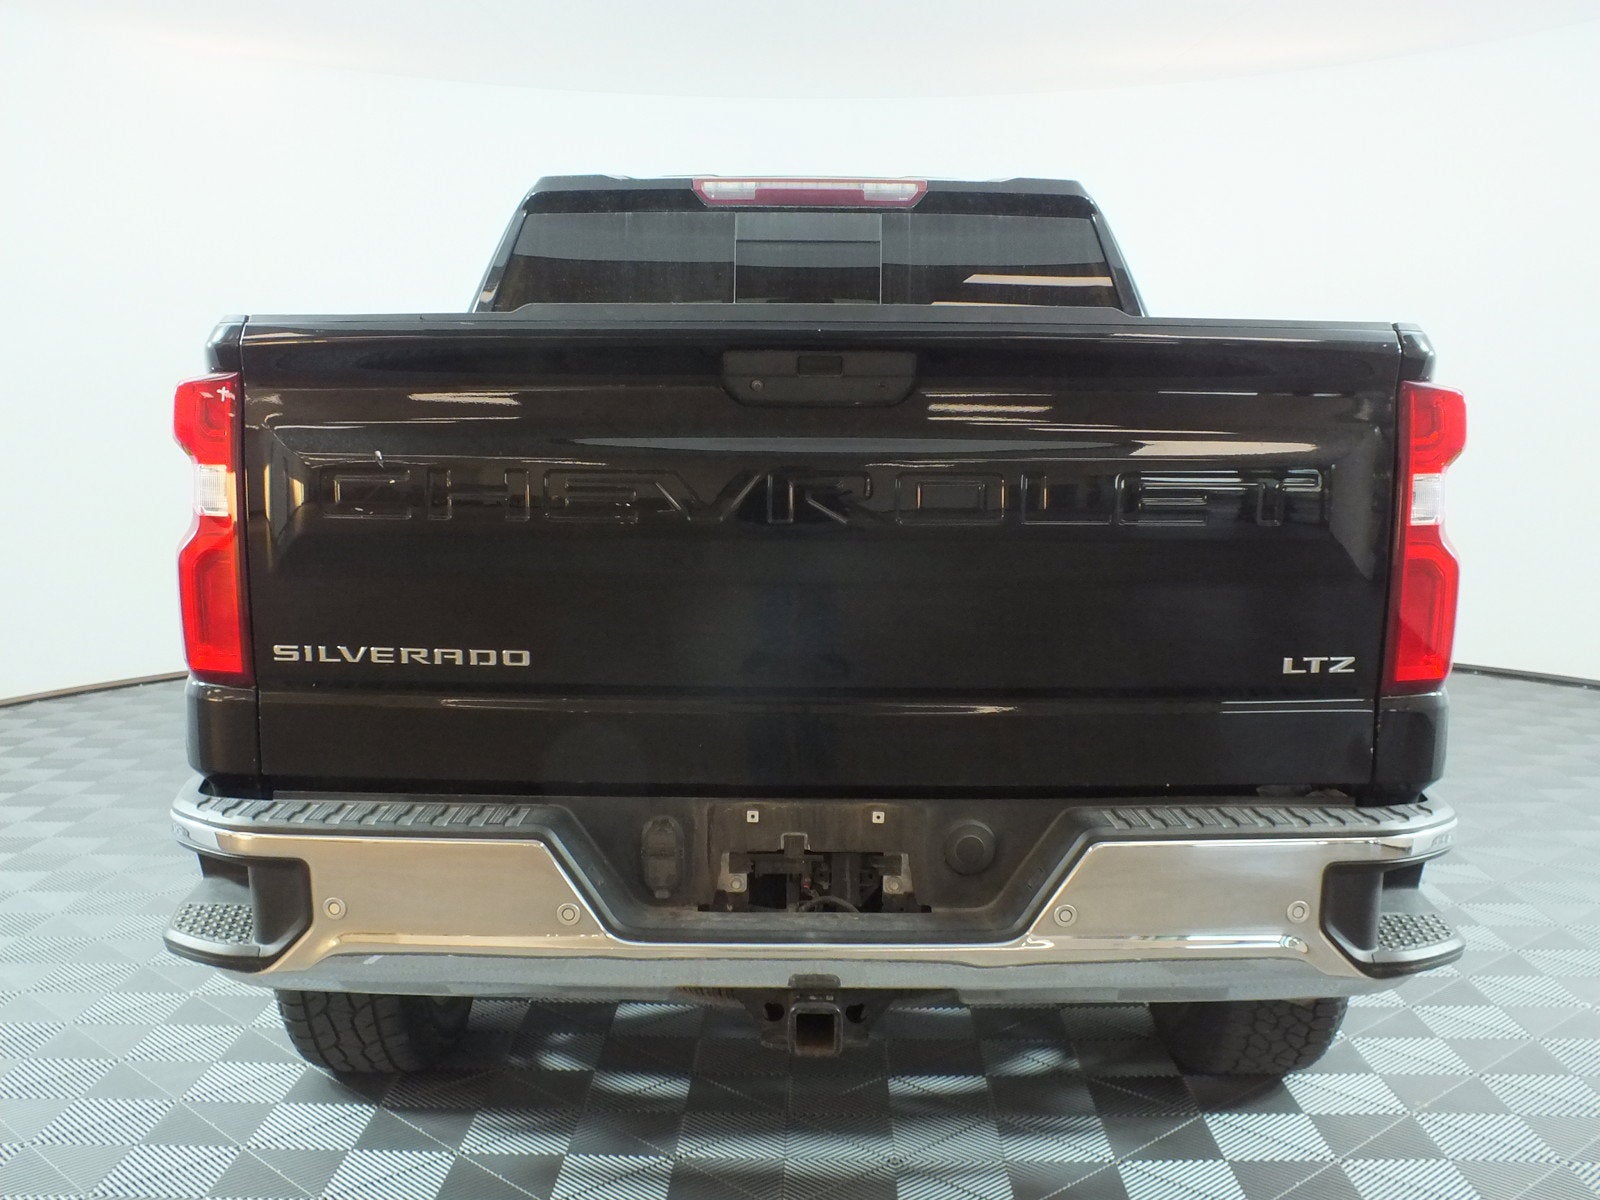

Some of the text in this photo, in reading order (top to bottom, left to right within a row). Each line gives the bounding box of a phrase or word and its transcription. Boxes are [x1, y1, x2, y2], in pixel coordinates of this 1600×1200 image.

[320, 467, 1323, 526] CHEVROLET
[273, 644, 532, 667] SILVERADO
[1281, 656, 1356, 675] LTZ
